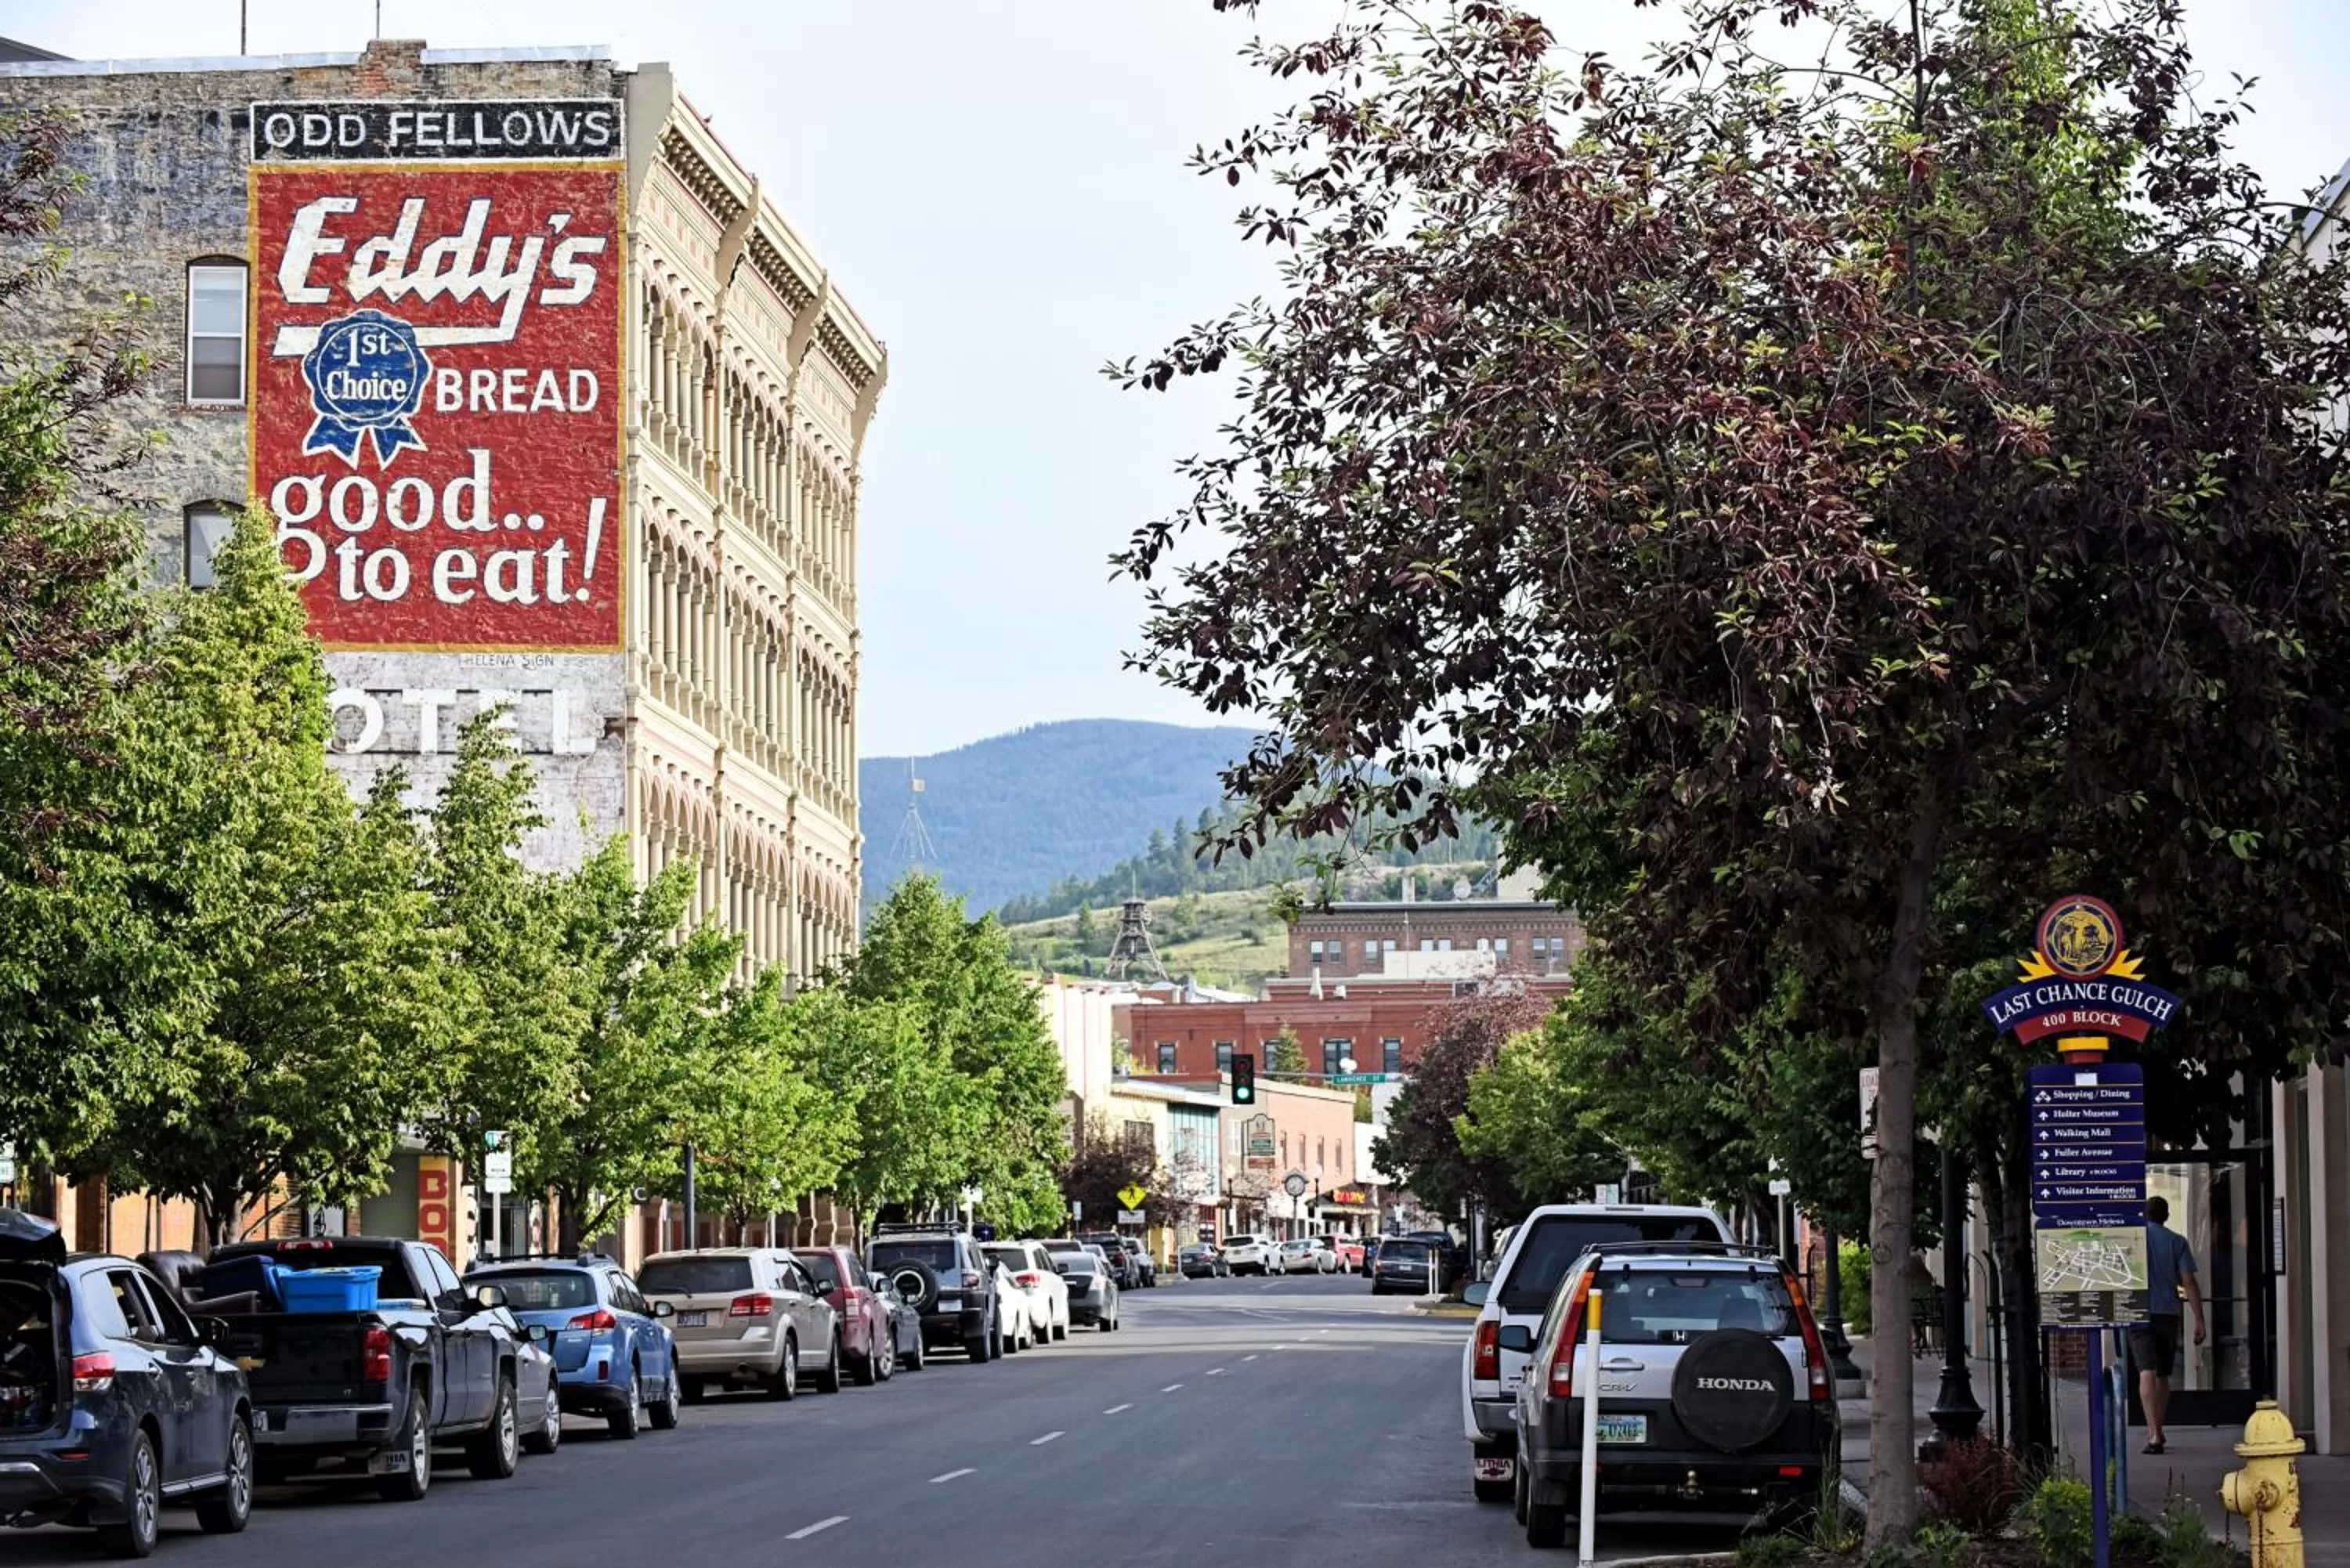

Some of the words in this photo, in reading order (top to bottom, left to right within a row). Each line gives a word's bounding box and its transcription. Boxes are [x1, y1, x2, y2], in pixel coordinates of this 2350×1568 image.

[265, 113, 367, 148] ODD
[390, 111, 611, 146] FELLOWS
[274, 196, 607, 346] Eddy's
[346, 330, 391, 368] 1st
[326, 370, 407, 402] Choice
[436, 367, 598, 414] BREAD
[334, 535, 410, 602] to
[432, 497, 607, 604] eat!
[520, 654, 554, 667] SIGN
[326, 688, 597, 755] OTEL
[1990, 992, 2034, 1024] LAST
[2036, 983, 2108, 1006] CHANCE
[2111, 986, 2174, 1021] GULCH
[2042, 1013, 2066, 1028] 400
[2073, 1011, 2121, 1027] BLOCK
[2053, 1090, 2094, 1100] Shopping
[2100, 1089, 2131, 1099] Dining
[2055, 1129, 2089, 1139] Walking
[2091, 1128, 2111, 1136] Mall
[2055, 1148, 2080, 1157] Fuller
[2055, 1168, 2085, 1177] Library
[2055, 1187, 2084, 1195] Visitor
[2086, 1185, 2136, 1194] Information
[1697, 1377, 1775, 1392] HONDA
